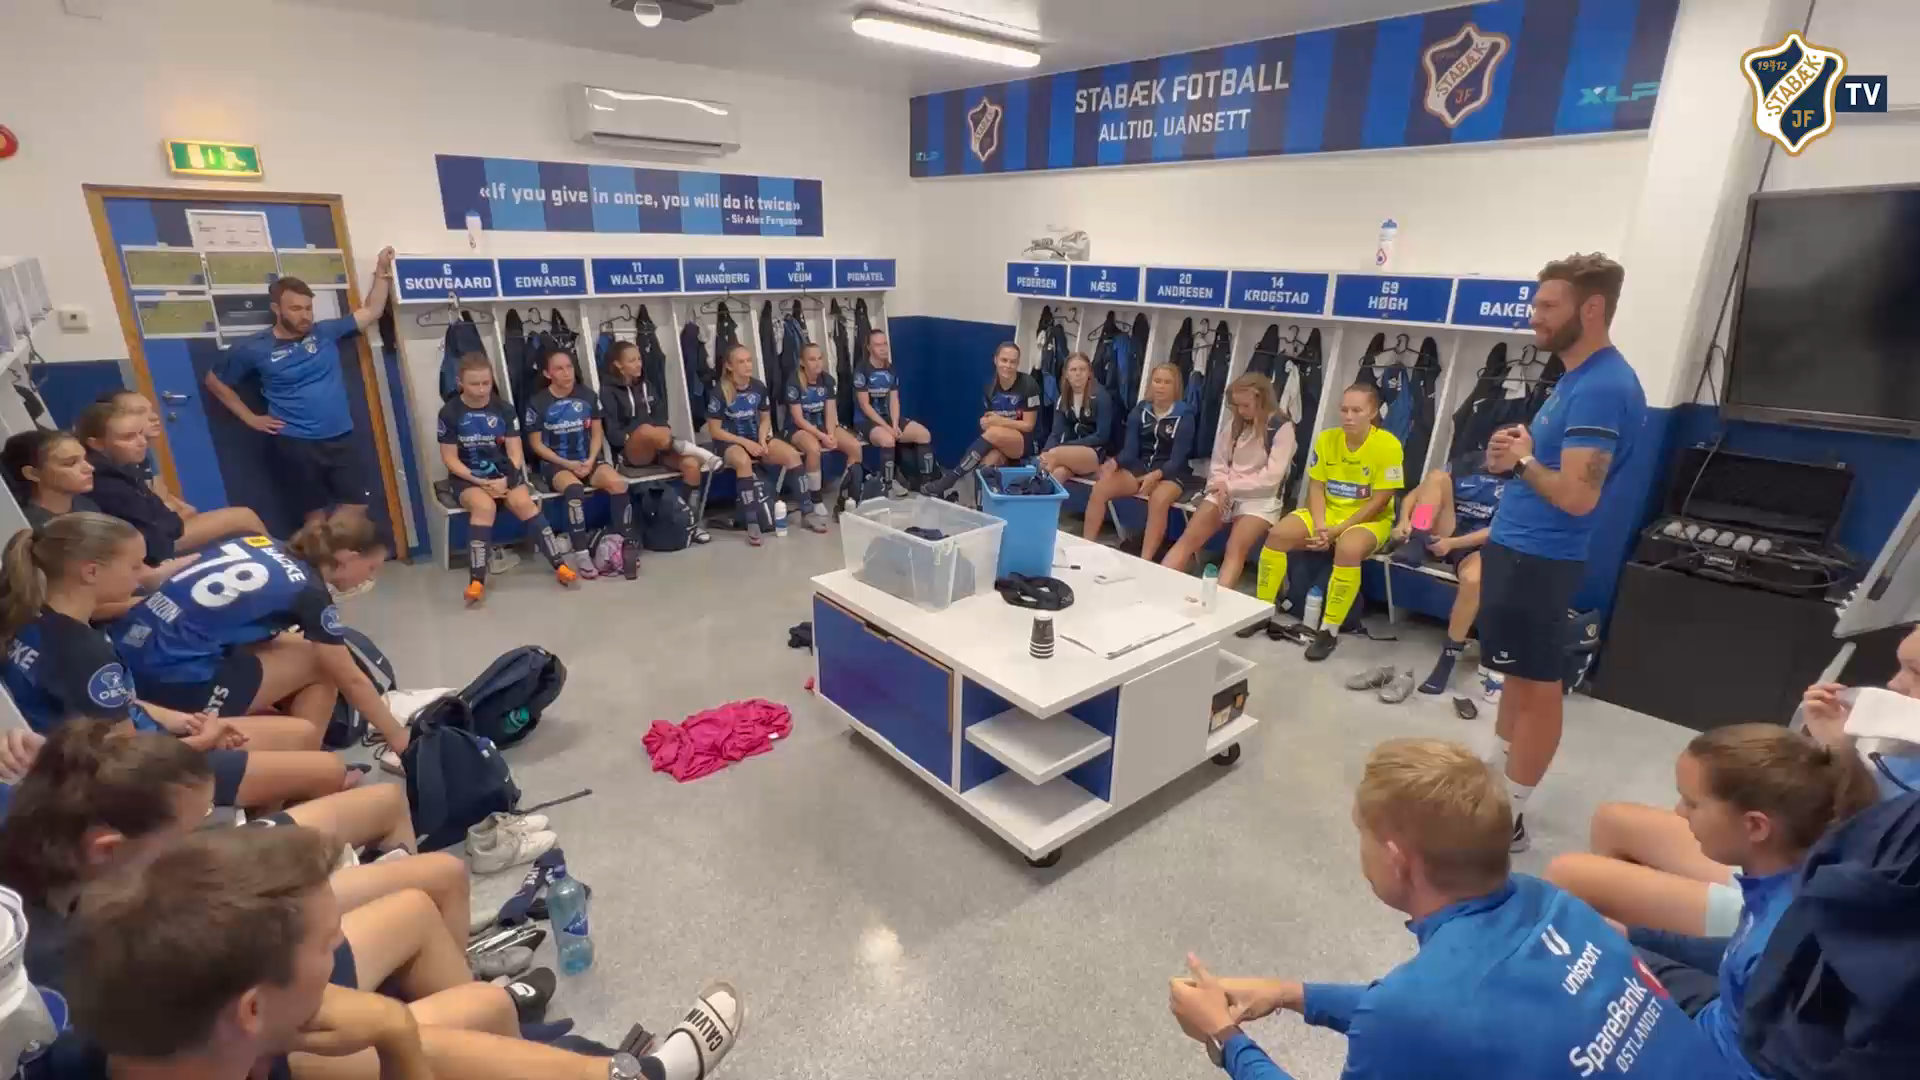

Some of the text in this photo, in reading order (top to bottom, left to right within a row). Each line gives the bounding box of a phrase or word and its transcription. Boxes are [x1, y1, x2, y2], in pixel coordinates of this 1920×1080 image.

[1075, 61, 1289, 113] STABÆK FOTBALL
[1455, 87, 1475, 104] JF
[1098, 108, 1251, 142] ALLTID. UANSETT
[479, 182, 801, 211] «If you give in once, you will do it twice»
[731, 214, 744, 225] Sir
[745, 214, 764, 225] Alex
[443, 263, 452, 275] 6
[540, 263, 549, 274] 8
[631, 262, 642, 273] 11
[718, 262, 726, 272] 4
[795, 262, 805, 271] 31
[1033, 267, 1040, 277] 2
[610, 274, 665, 286] WALSTAD
[695, 273, 750, 285] WANGBERG
[787, 272, 812, 283] VEUM
[1100, 269, 1107, 280] 3
[1178, 273, 1192, 285] 20
[405, 276, 492, 291] SKOVGAARD
[515, 276, 577, 288] EDWARDS
[1016, 276, 1057, 290] PEDERSEN
[1090, 281, 1117, 293] NÆSS
[1270, 276, 1284, 289] 14
[1381, 281, 1399, 295] 69
[1157, 285, 1214, 299] ANDRESEN
[1243, 289, 1310, 305] KROGSTAD
[1518, 285, 1530, 301] 9
[1368, 295, 1409, 311] HØGH
[170, 543, 269, 608] 78
[1562, 940, 1602, 995] unisport
[684, 1008, 723, 1052] CALVIN
[1569, 976, 1648, 1078] SpareBank
[1615, 996, 1663, 1074] ØSTLANDET
